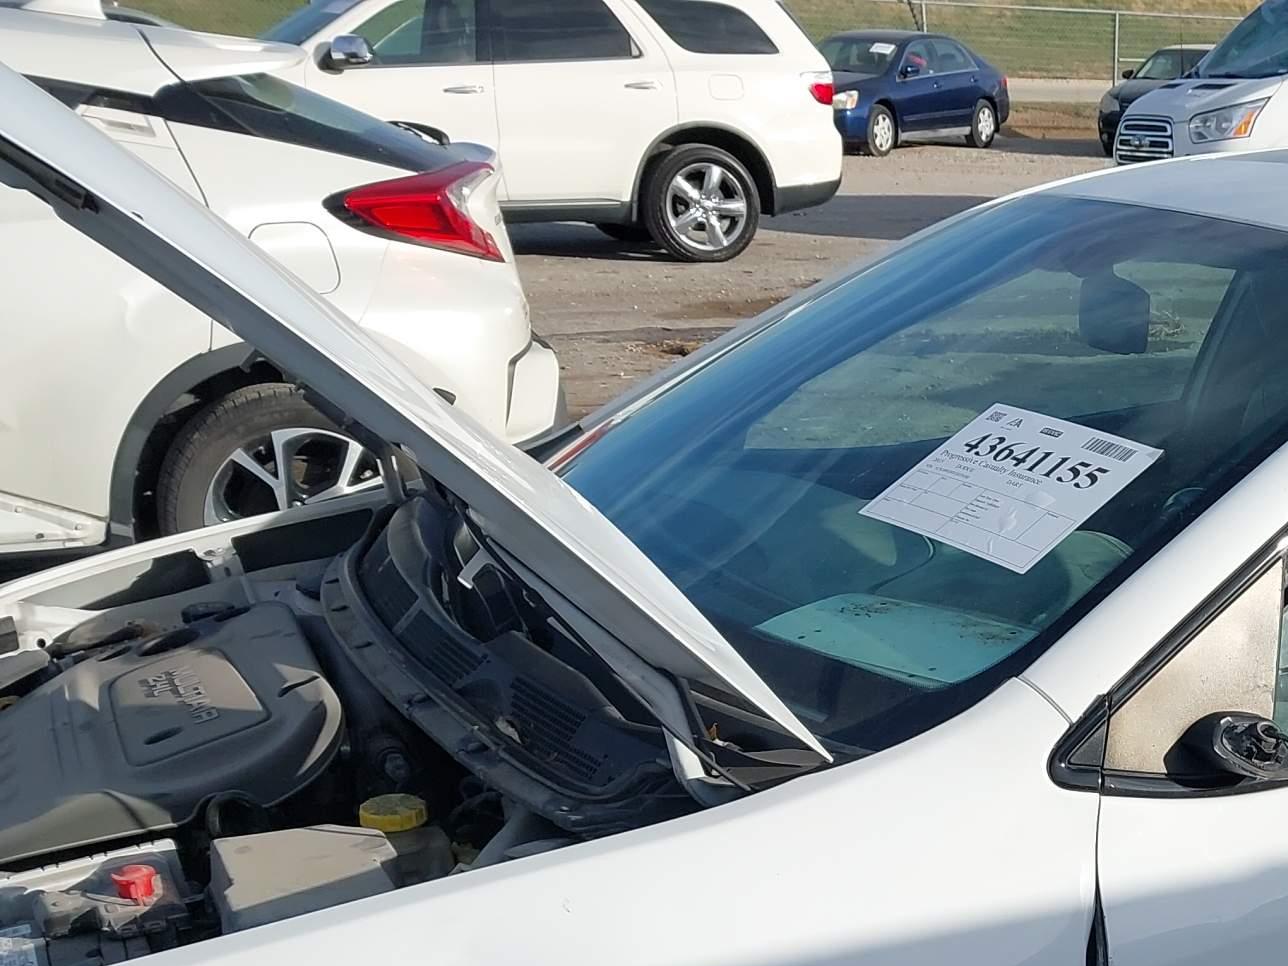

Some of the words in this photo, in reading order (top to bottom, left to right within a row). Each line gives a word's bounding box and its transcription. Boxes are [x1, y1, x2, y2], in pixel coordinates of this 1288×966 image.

[940, 449, 979, 464] Progressive
[978, 459, 1008, 475] Casualty
[1008, 470, 1043, 485] Insurance
[963, 433, 1111, 489] 43641155
[1006, 479, 1024, 488] DART
